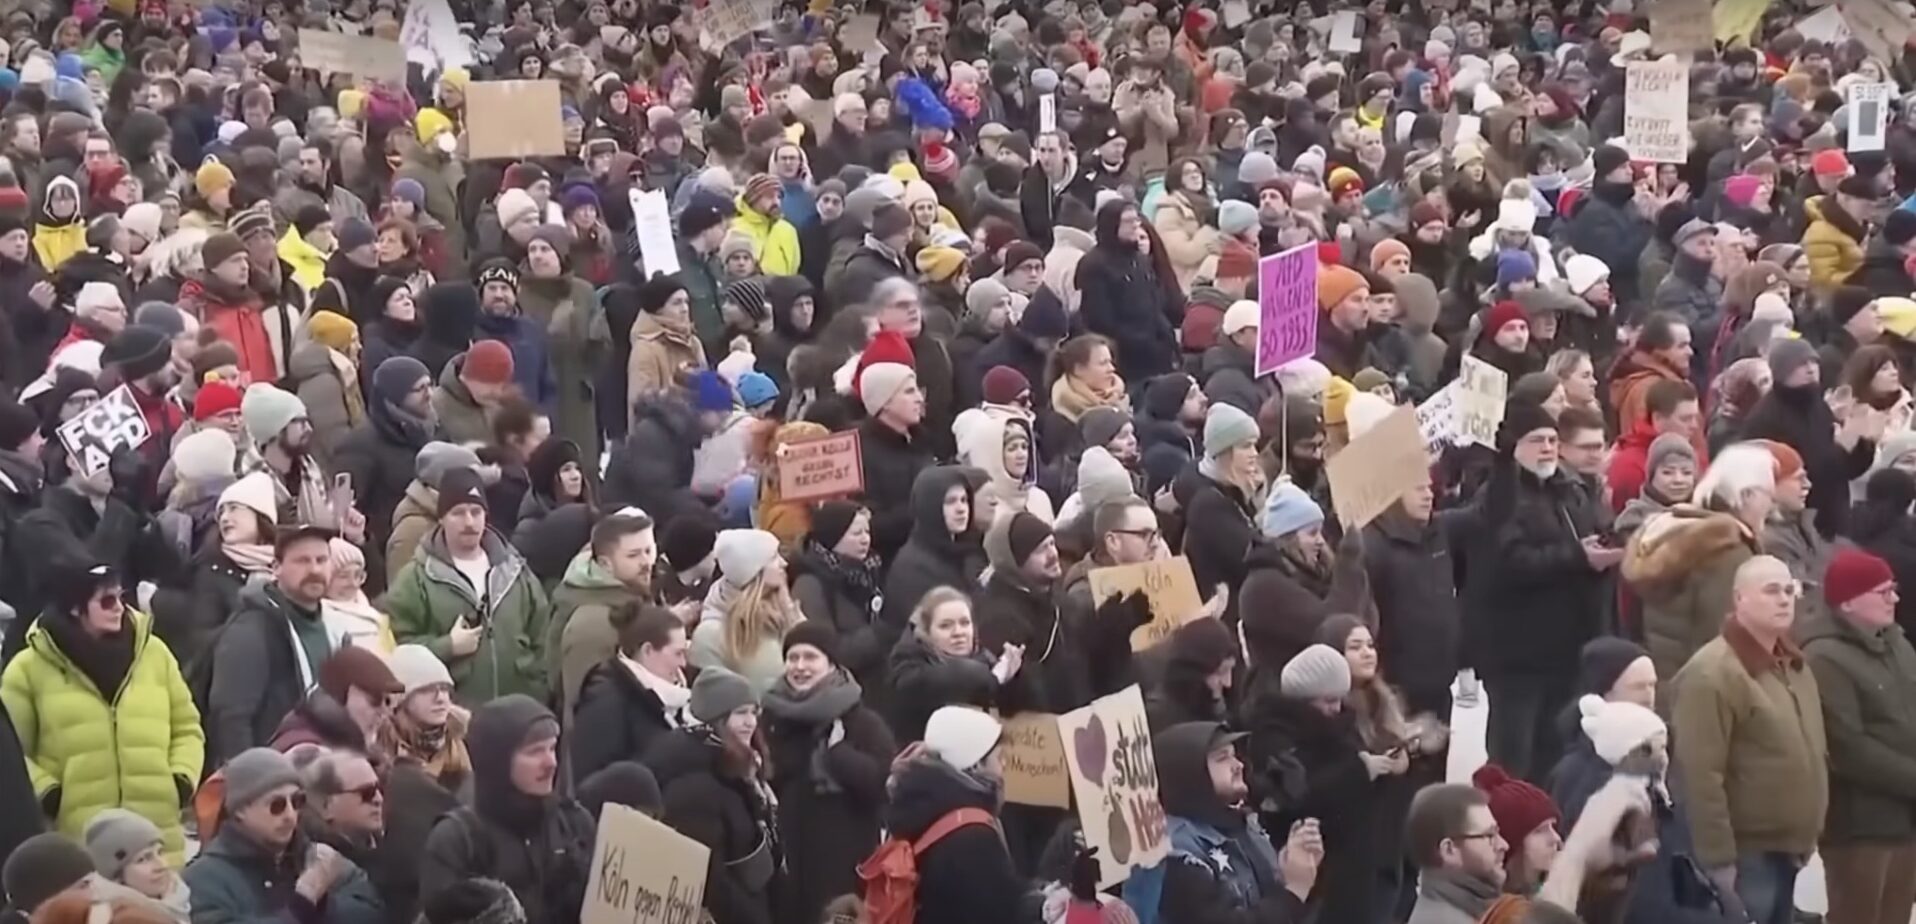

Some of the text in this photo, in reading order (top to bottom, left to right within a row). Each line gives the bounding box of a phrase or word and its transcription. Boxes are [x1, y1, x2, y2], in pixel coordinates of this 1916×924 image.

[480, 267, 518, 288] YEAH
[62, 390, 137, 454] FCK
[84, 416, 146, 478] AFD
[597, 842, 630, 911] Köln
